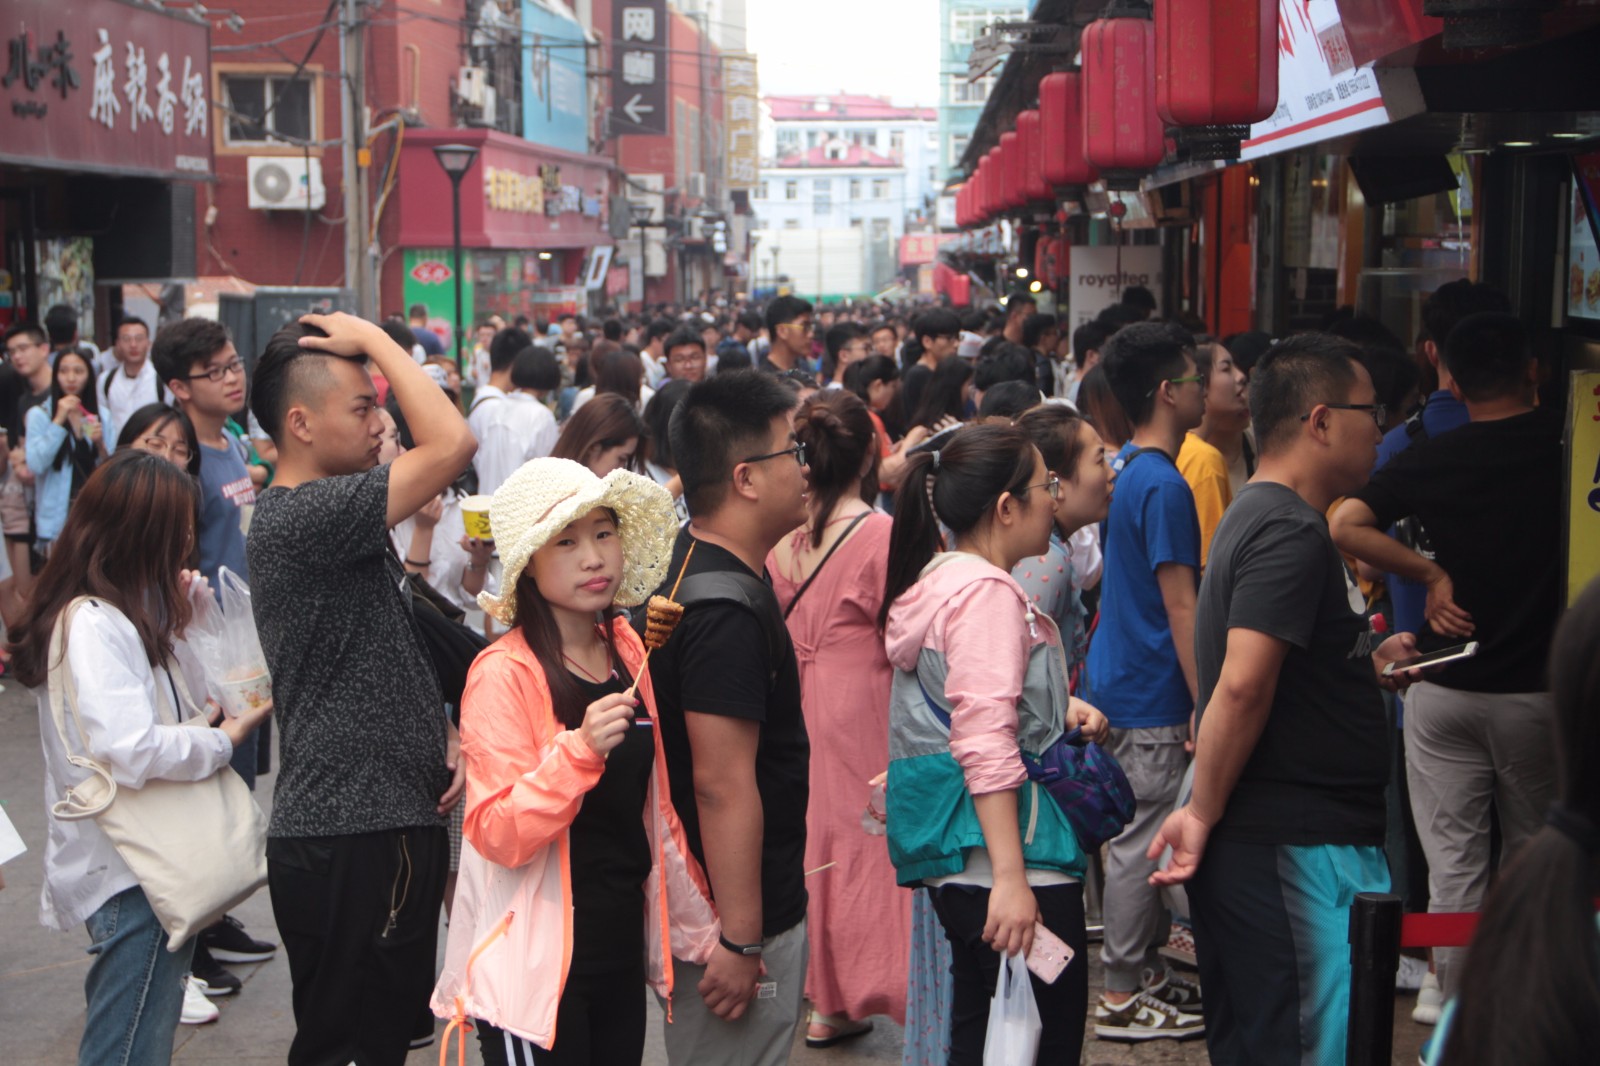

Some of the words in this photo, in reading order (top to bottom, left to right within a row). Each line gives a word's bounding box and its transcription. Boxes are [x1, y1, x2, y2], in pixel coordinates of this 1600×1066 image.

[89, 27, 208, 138] 麻辣香锅
[729, 59, 754, 182] 美食广场
